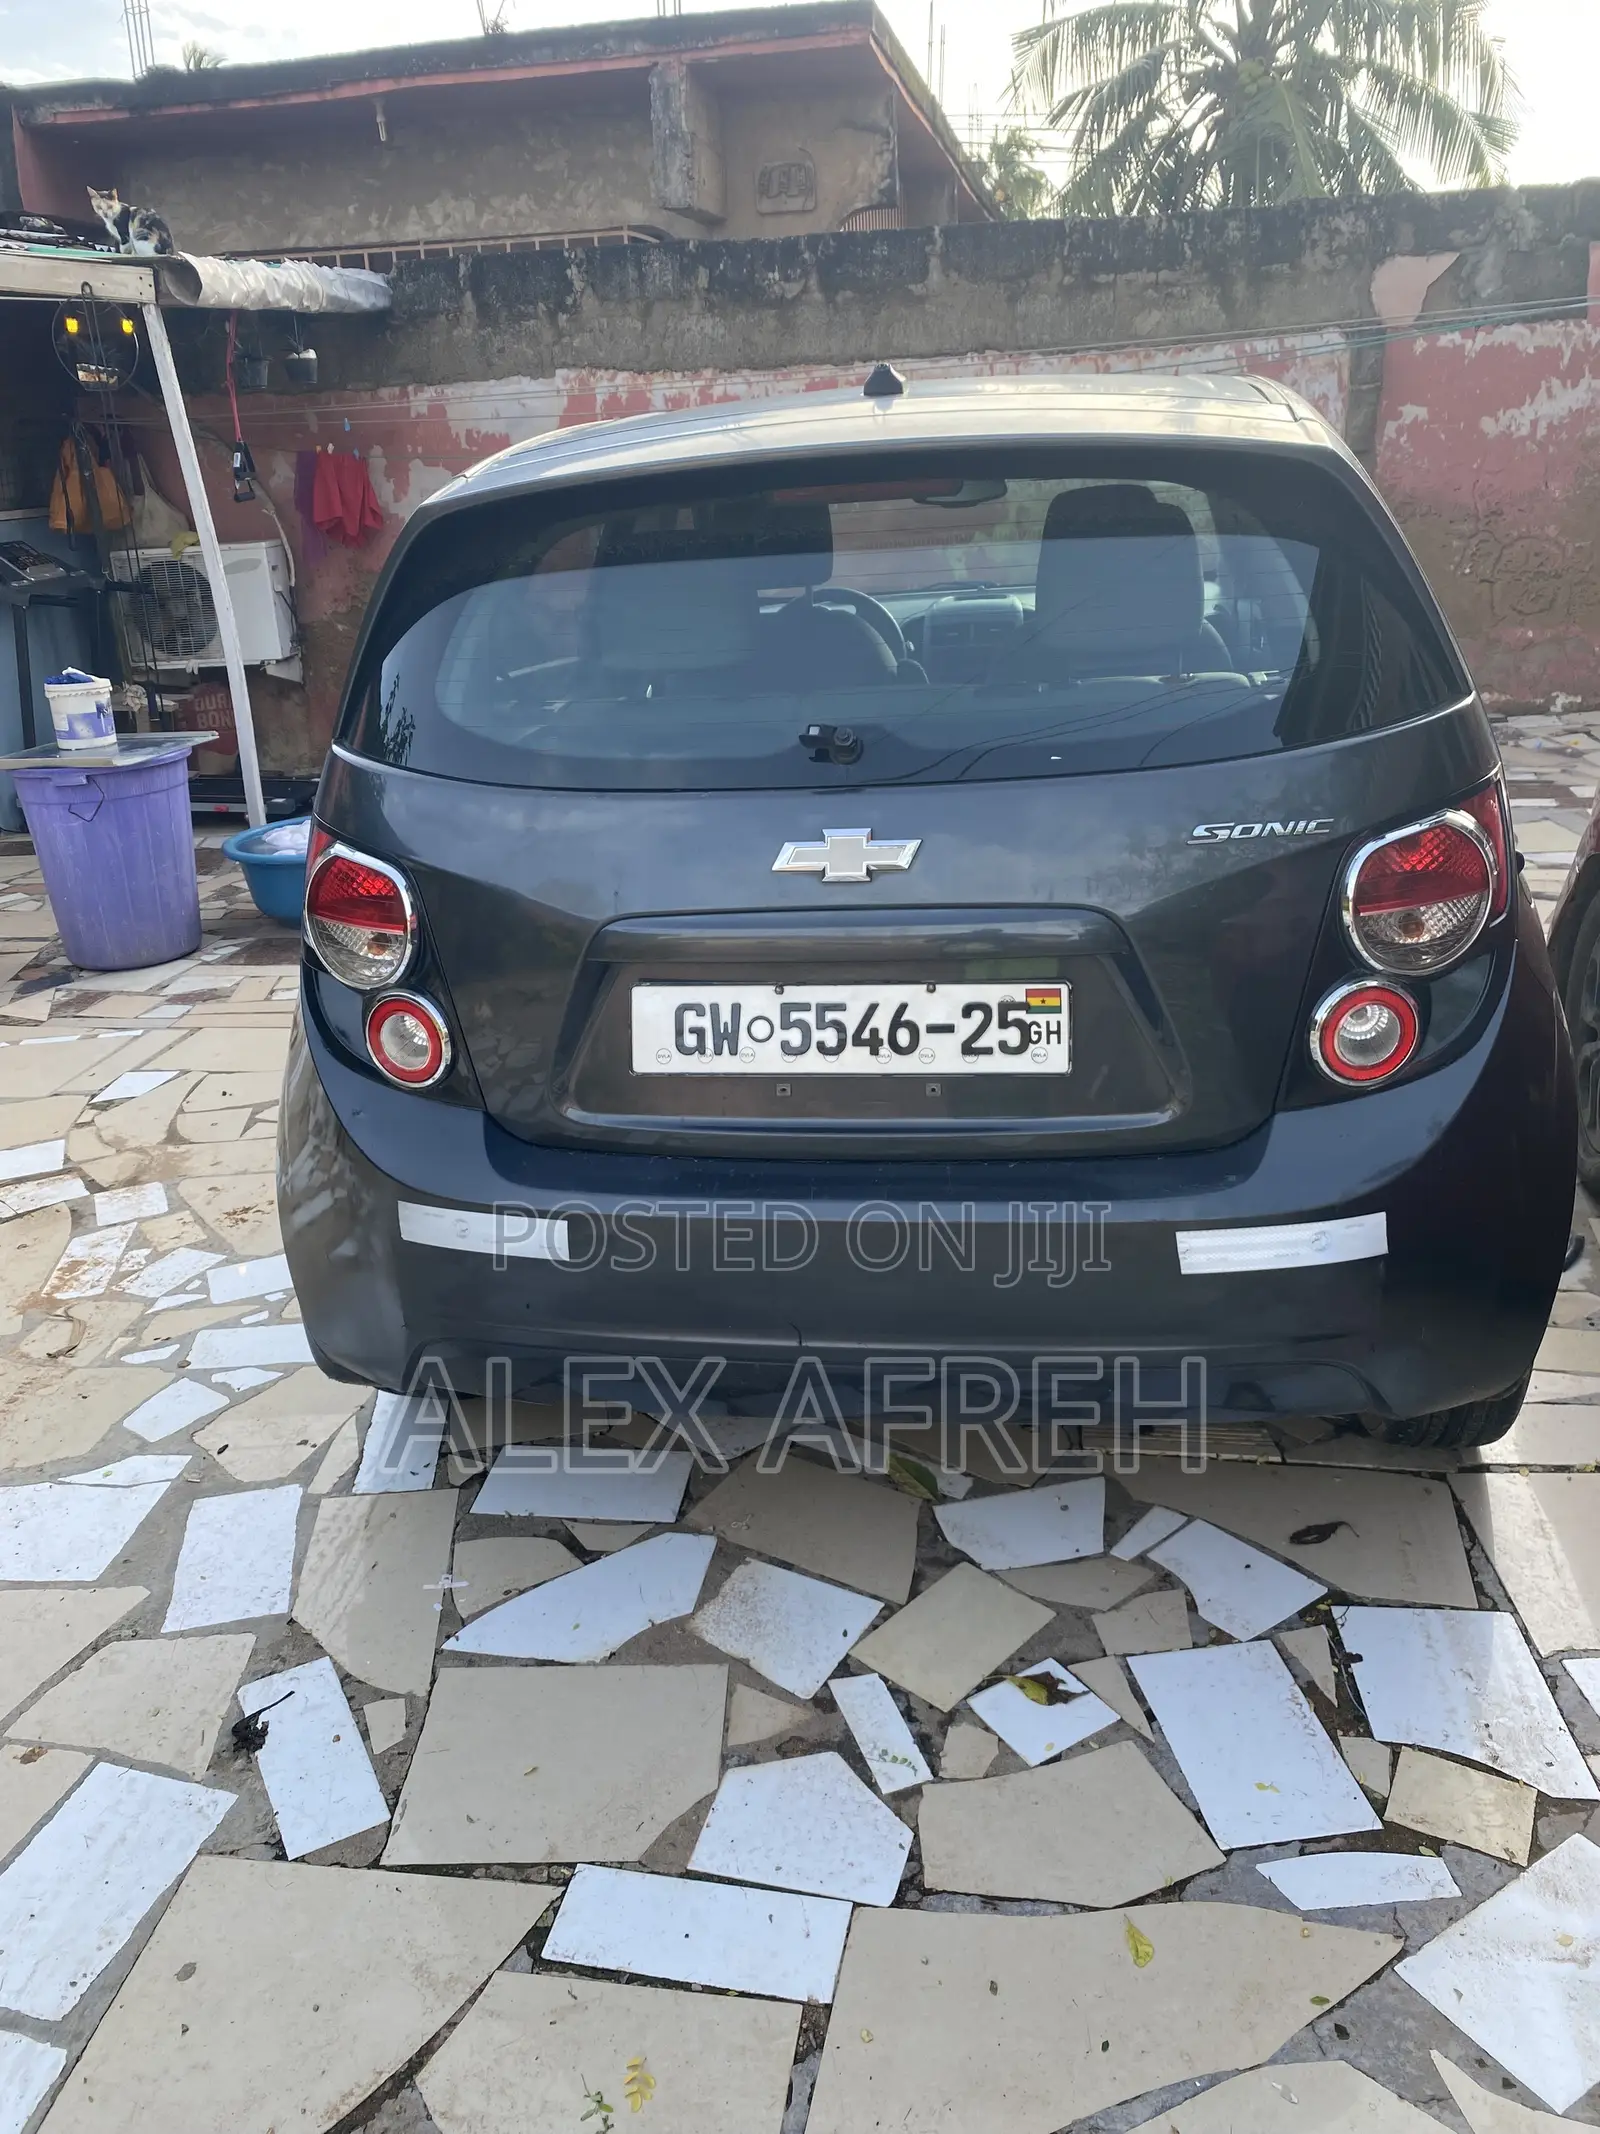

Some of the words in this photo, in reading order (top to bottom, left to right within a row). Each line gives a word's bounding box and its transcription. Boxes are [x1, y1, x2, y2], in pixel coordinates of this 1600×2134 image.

[197, 708, 236, 729] BON
[1186, 818, 1335, 845] SONIC
[674, 1002, 742, 1057] GW
[780, 1001, 1031, 1056] 5546-25
[1028, 1020, 1062, 1045] GH
